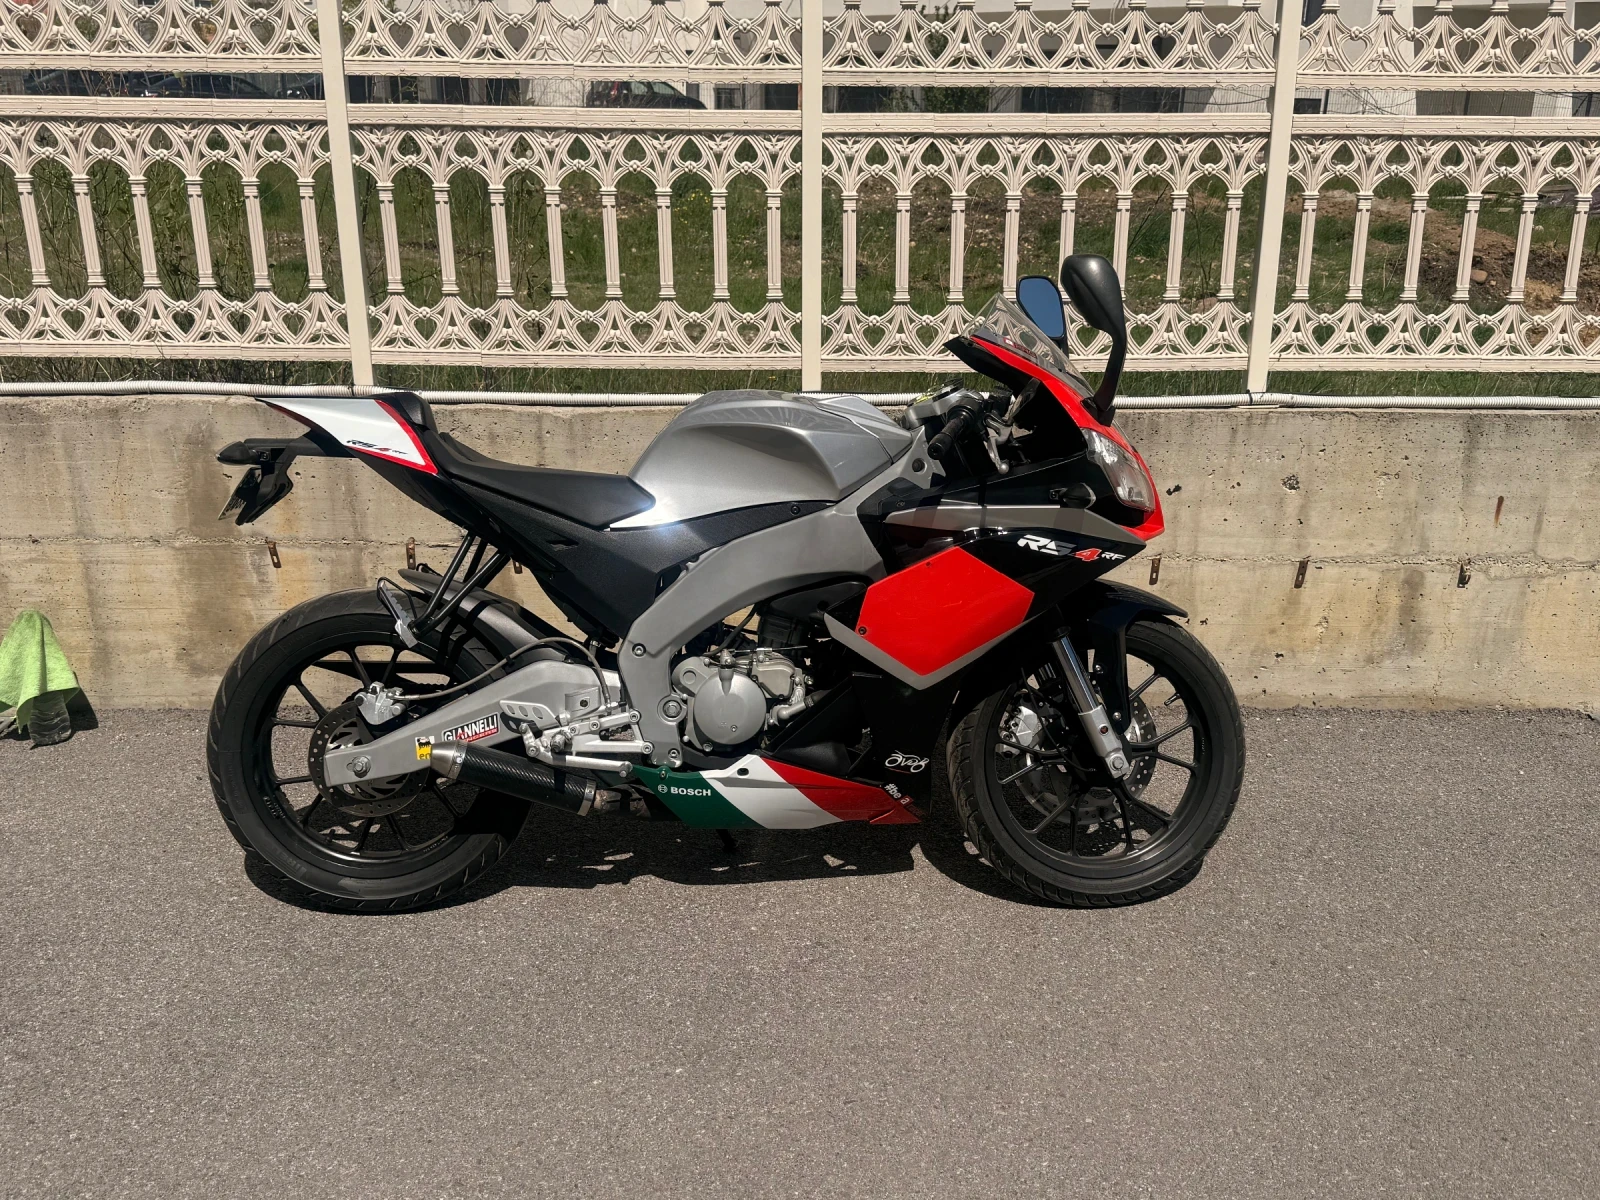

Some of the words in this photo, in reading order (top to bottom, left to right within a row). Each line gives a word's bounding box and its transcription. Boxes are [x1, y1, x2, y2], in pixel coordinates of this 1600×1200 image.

[444, 714, 497, 743] GIANNELLI
[418, 752, 432, 760] en
[670, 786, 711, 797] BOSCH
[884, 783, 902, 799] #be
